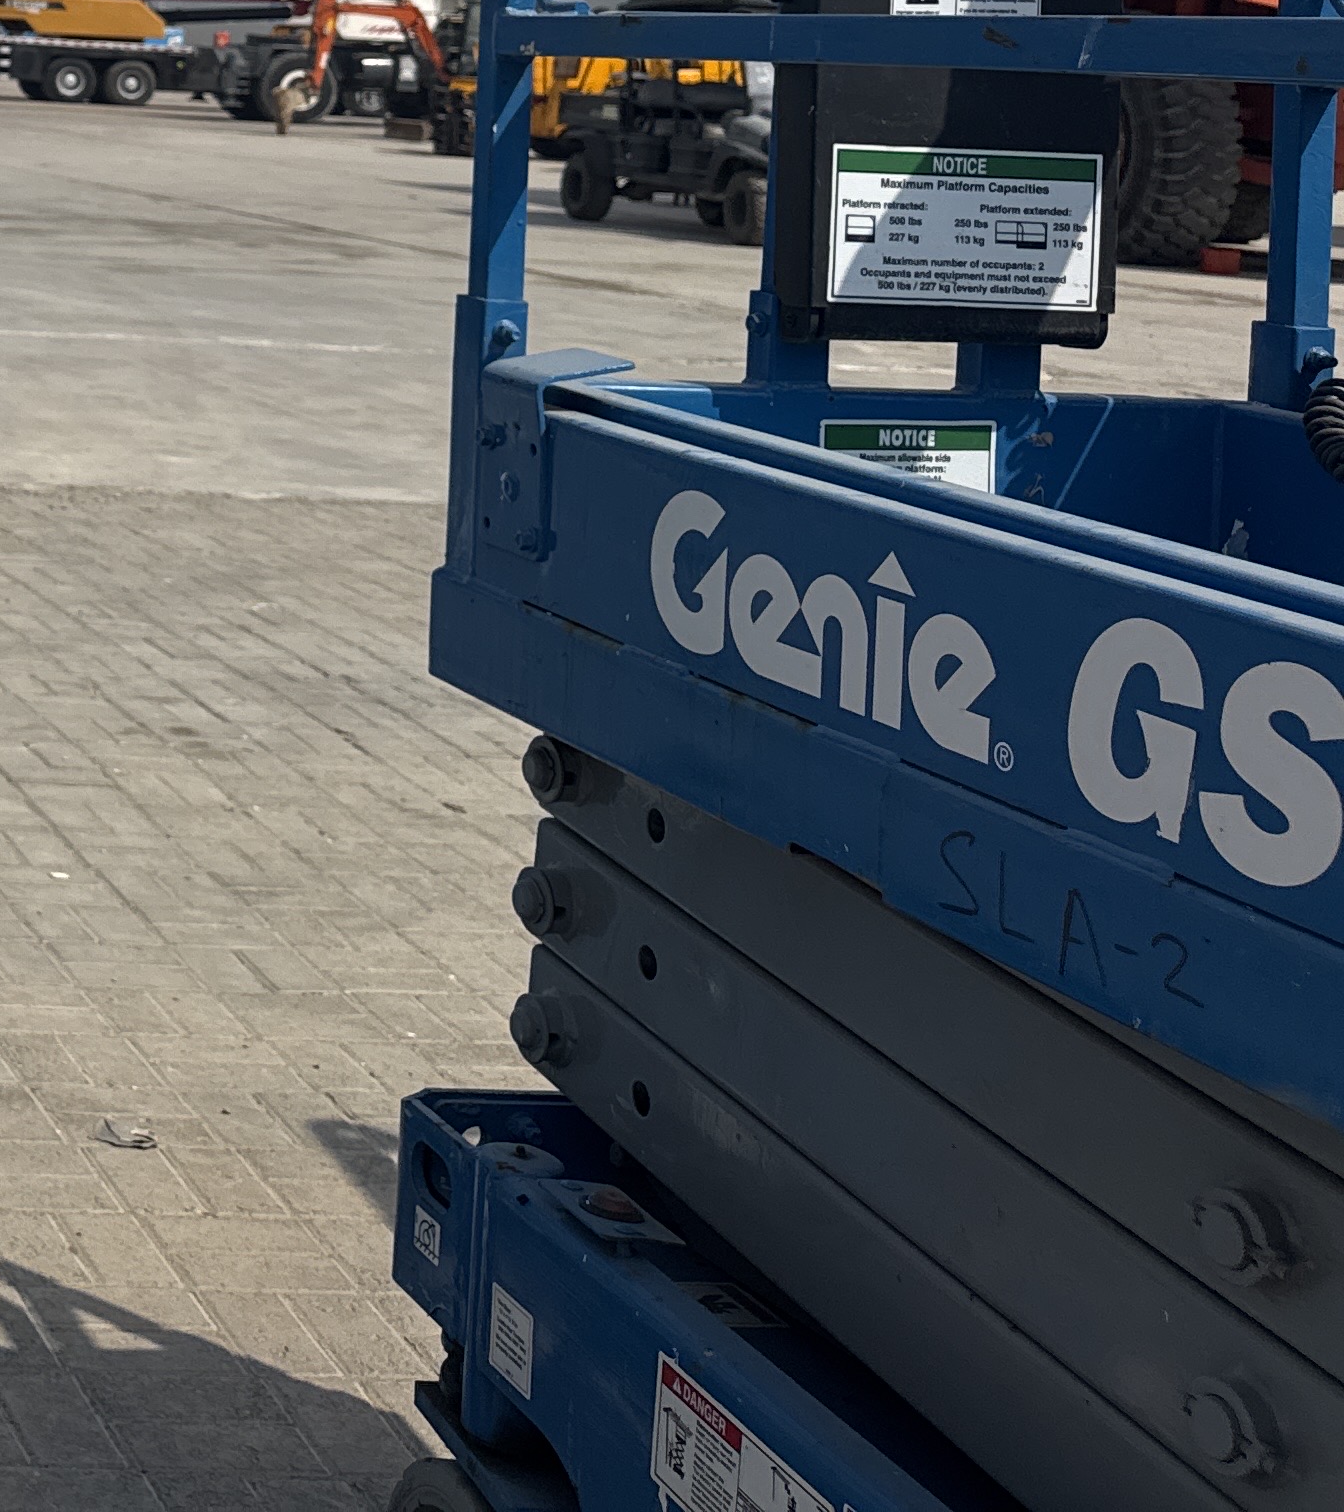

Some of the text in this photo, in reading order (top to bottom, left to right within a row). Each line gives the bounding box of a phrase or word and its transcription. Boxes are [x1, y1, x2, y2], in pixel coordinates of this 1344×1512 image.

[932, 156, 988, 175] NOTICE
[880, 178, 1050, 196] Maximum Platform Capacities
[842, 198, 928, 211] Platform retracted:
[979, 204, 1072, 217] Platform extended:
[889, 216, 906, 225] 500
[954, 218, 989, 229] 250 lbs
[1053, 222, 1088, 233] 250 lbs
[888, 233, 920, 244] 227 kg
[955, 236, 985, 247] 113 kg
[1053, 239, 1083, 250] 113 kg
[883, 256, 1045, 271] Maximum number of occupants: 2
[860, 267, 1067, 285] Occupants and equipment must not exceed
[939, 283, 951, 294] kg
[879, 428, 936, 447] NOTICE
[859, 453, 896, 462] Maximum
[935, 454, 951, 463] side
[650, 490, 996, 764] Genie
[937, 830, 1203, 1008] SLA-2
[682, 1384, 728, 1437] DANGER
